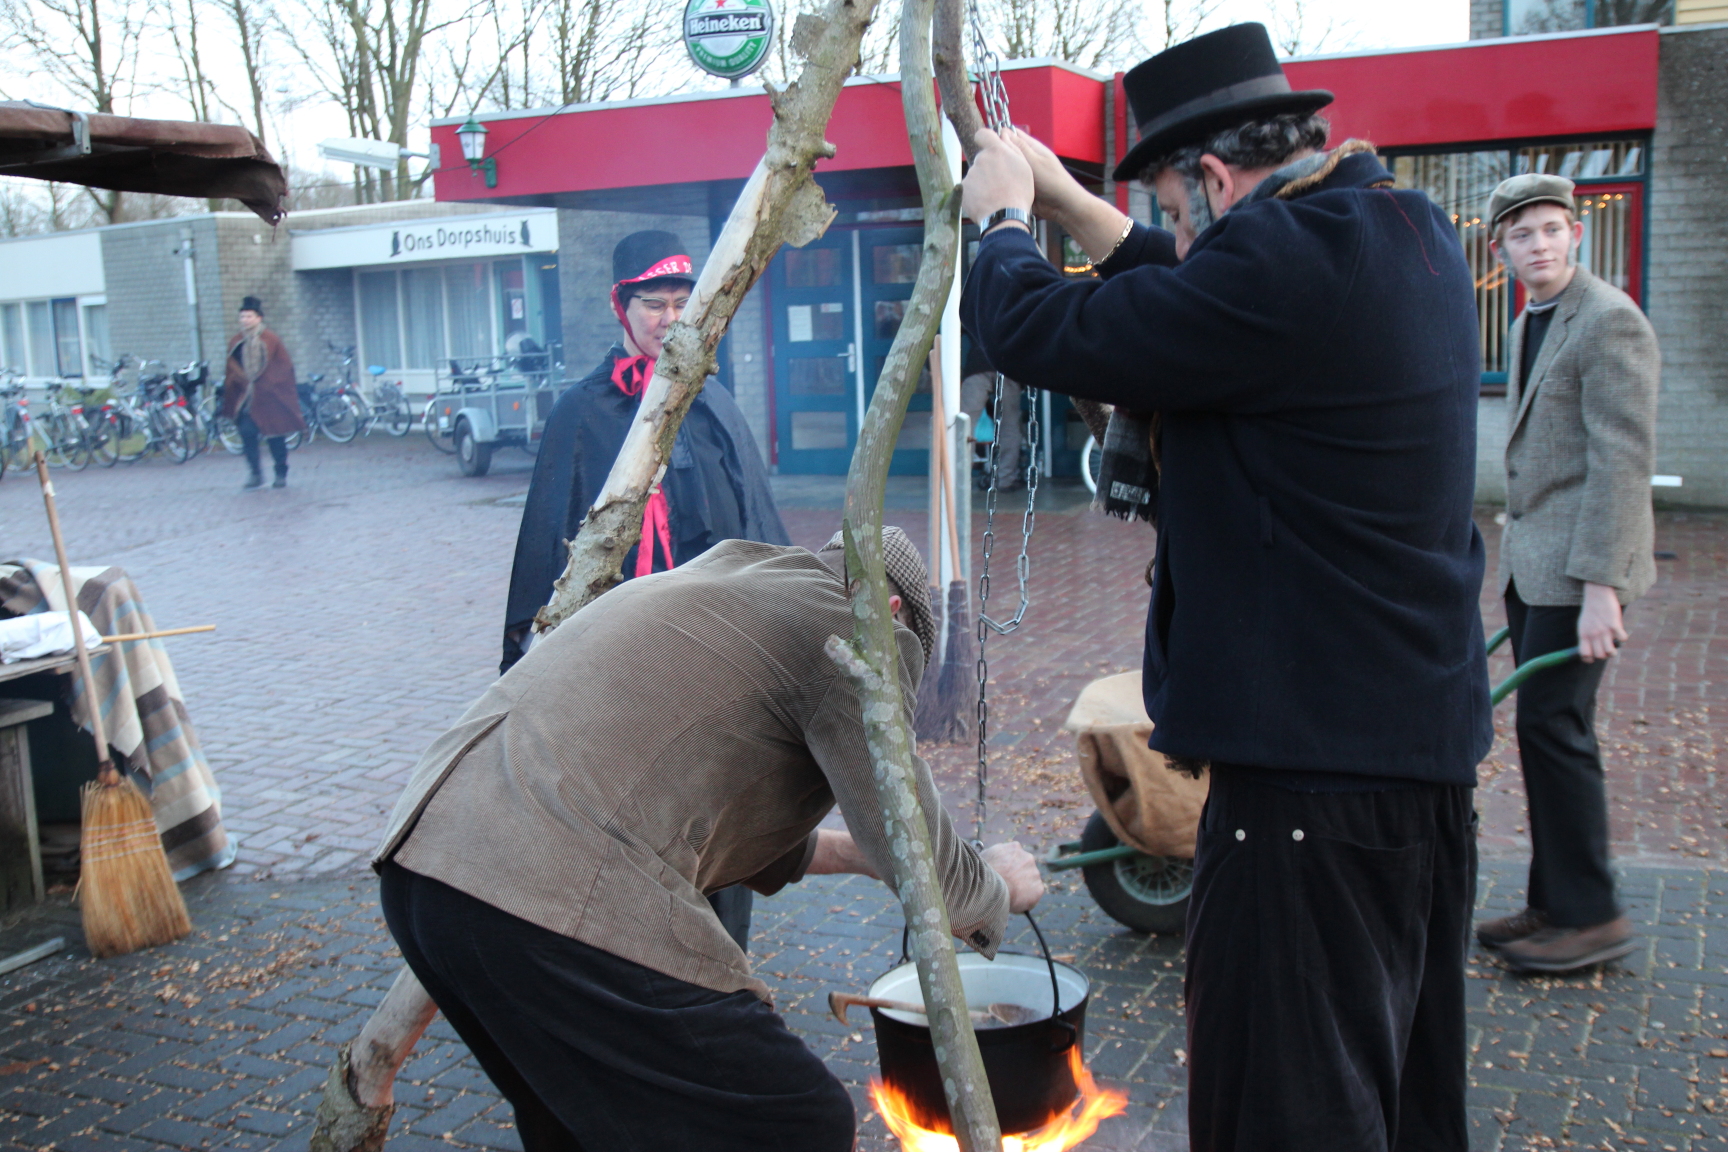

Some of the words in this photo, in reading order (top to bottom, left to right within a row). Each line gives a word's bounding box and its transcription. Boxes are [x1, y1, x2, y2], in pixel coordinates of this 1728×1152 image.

[690, 14, 762, 36] Heineken
[728, 41, 757, 67] QUALITY
[404, 233, 434, 251] Ons
[437, 224, 516, 249] Dorpshuis
